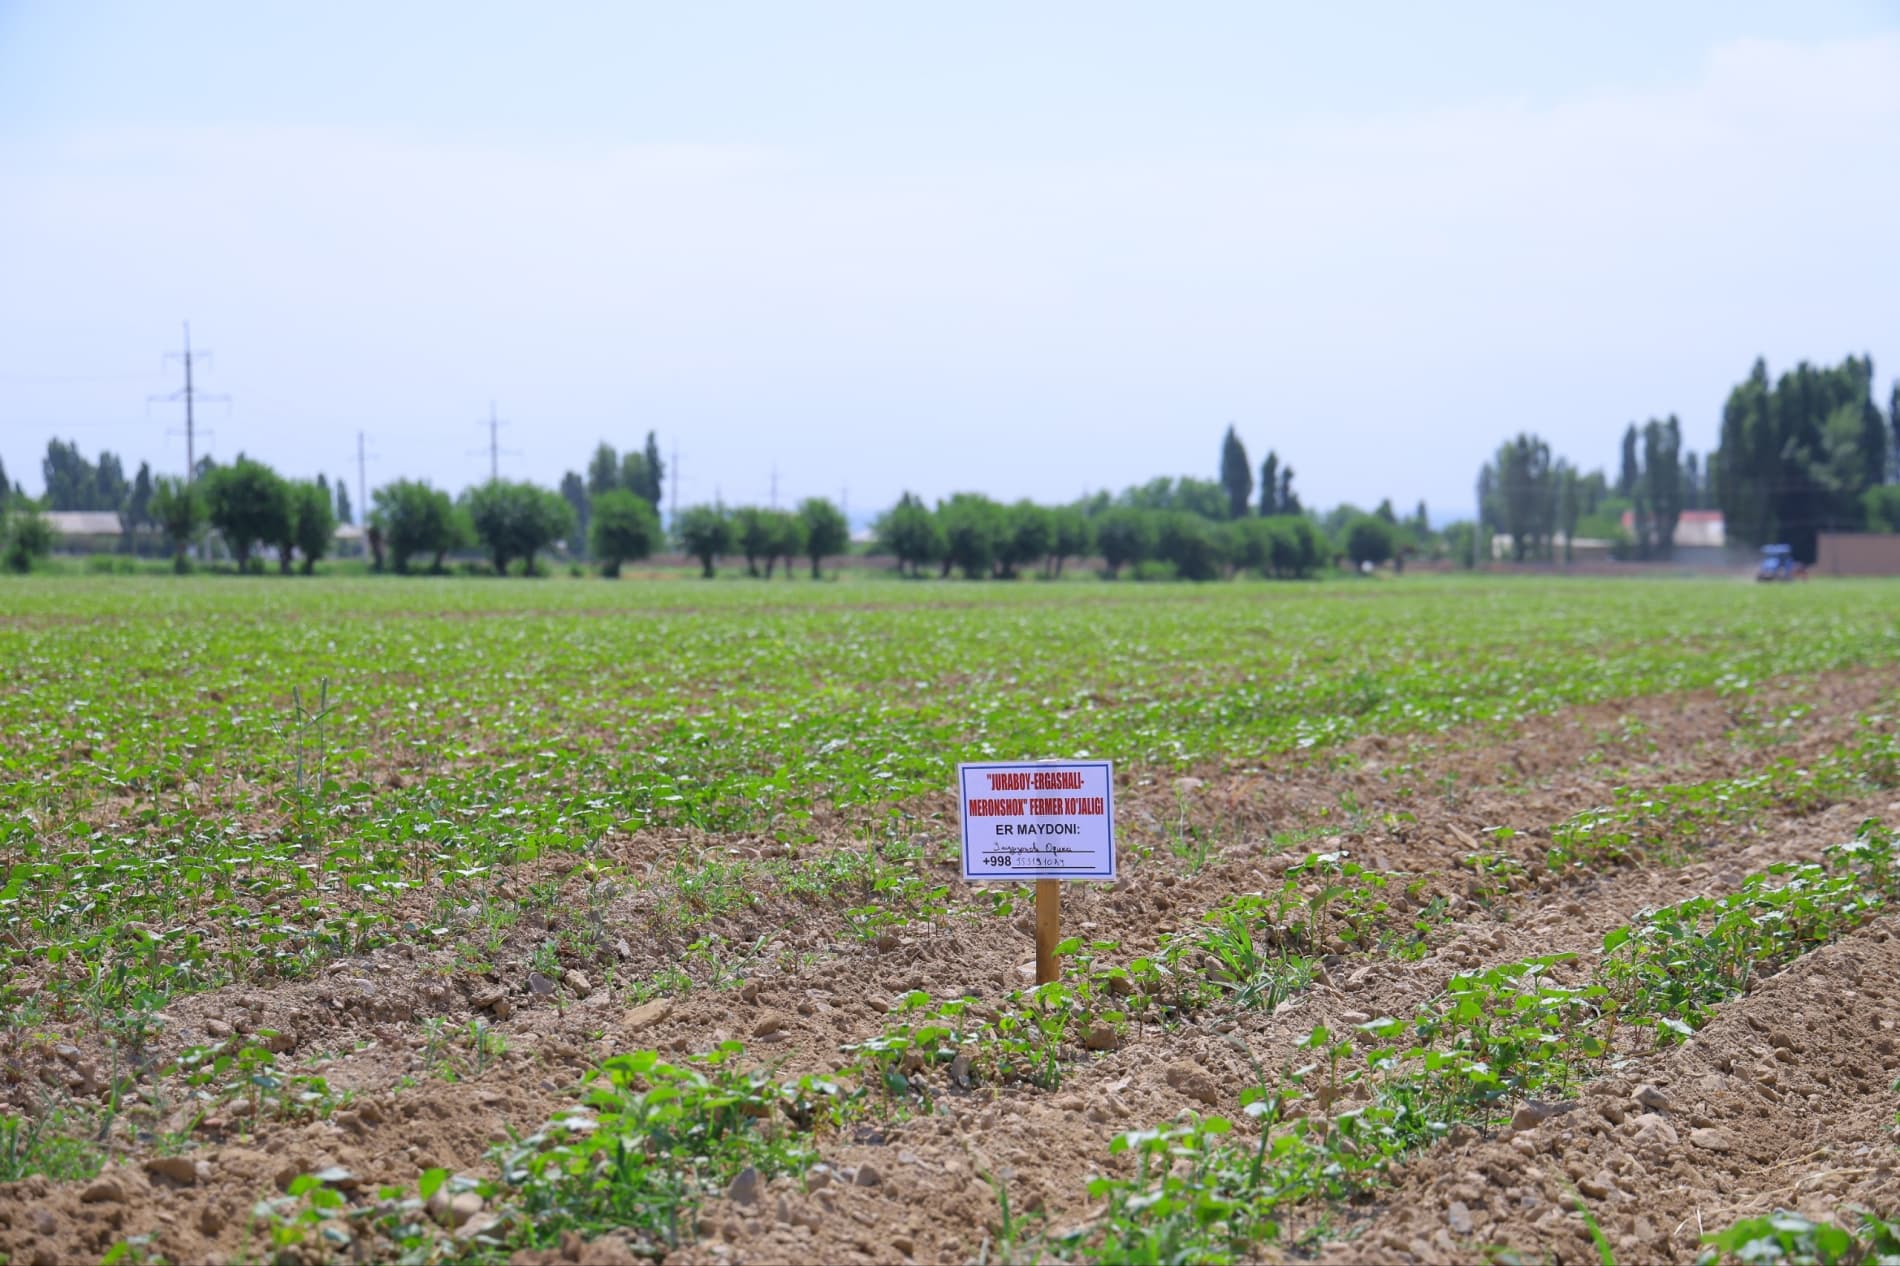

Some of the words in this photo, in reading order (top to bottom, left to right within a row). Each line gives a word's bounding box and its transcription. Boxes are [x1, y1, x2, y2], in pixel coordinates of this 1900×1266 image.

[1030, 798, 1062, 815] FERMER
[996, 824, 1013, 835] ER
[1017, 823, 1080, 835] MAYDONI:
[983, 855, 1011, 867] +998
